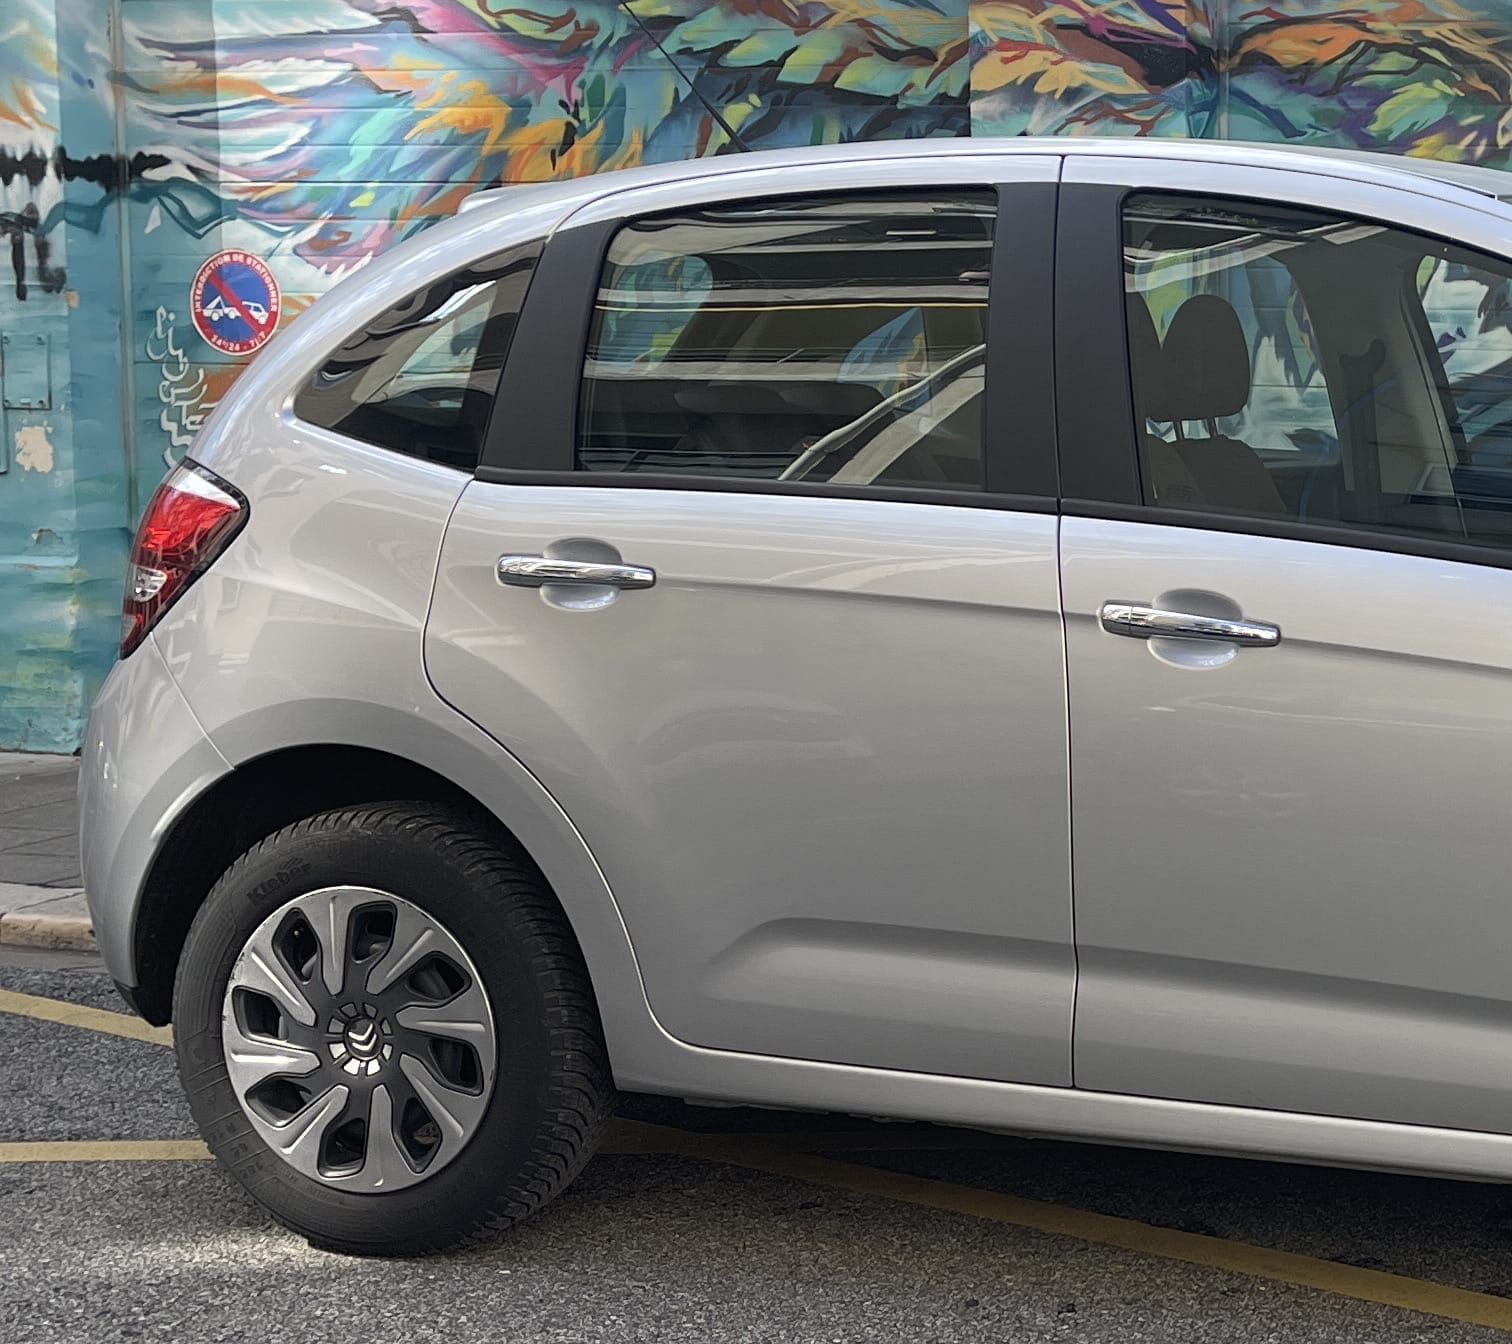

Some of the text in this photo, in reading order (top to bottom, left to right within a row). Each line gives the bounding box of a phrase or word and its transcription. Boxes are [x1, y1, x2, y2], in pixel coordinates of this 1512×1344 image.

[195, 253, 278, 313] INTERDICTION DE STATIONNER
